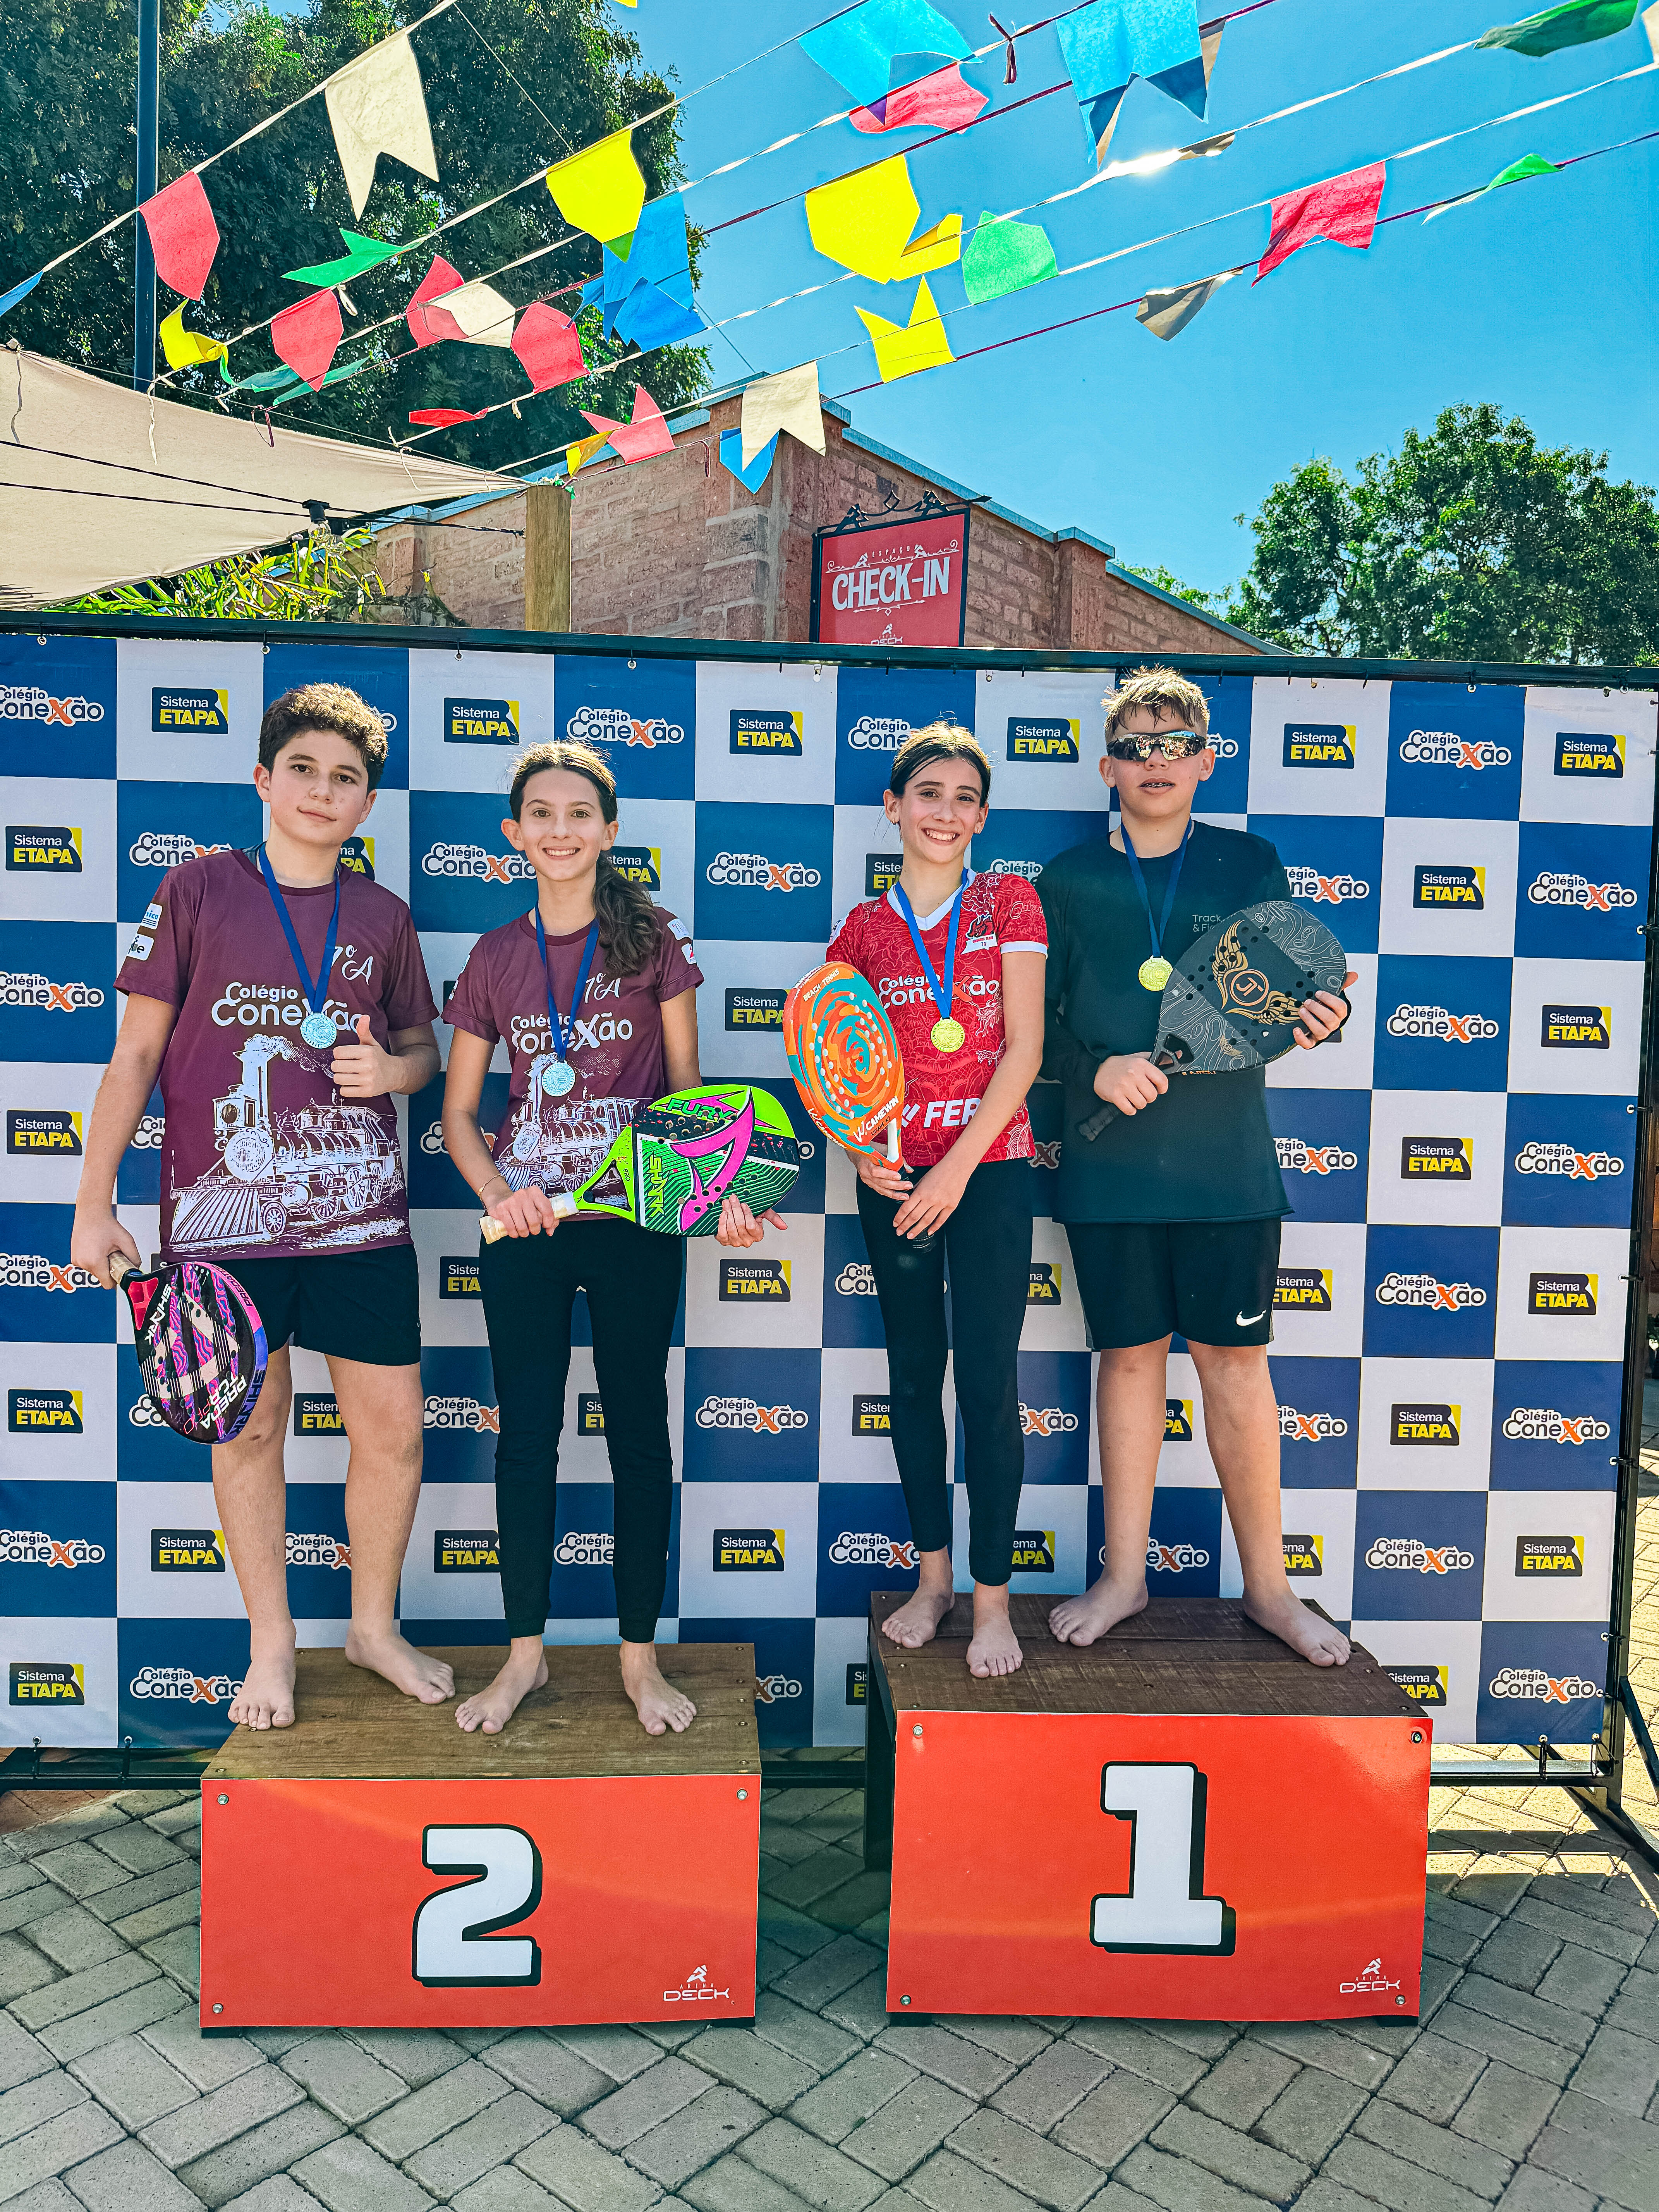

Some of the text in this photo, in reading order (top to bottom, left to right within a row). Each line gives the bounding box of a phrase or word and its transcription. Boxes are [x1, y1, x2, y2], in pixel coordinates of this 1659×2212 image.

[832, 556, 950, 611] CHECK-IN
[160, 697, 208, 708] Sistema
[160, 711, 220, 725] ETAPA
[452, 706, 500, 719] Sistema
[579, 708, 628, 723] Colégio
[452, 720, 510, 737] ETAPA
[738, 718, 783, 730] Sistema
[859, 718, 907, 733] Colégio
[1015, 725, 1060, 737] Sistema
[738, 732, 794, 748] ETAPA
[1292, 731, 1337, 744] Sistema
[1412, 732, 1458, 746] Colégio
[1015, 738, 1070, 755] ETAPA
[1290, 745, 1346, 761] ETAPA
[1563, 740, 1607, 752] Sistema
[1561, 753, 1616, 770] ETAPA
[14, 835, 62, 847] Sistema
[141, 834, 192, 849] Colégio
[14, 848, 72, 864] ETAPA
[434, 844, 483, 859] Colégio
[718, 853, 766, 868] Colégio
[874, 862, 903, 873] Siste
[993, 859, 1041, 874] Colégio
[1422, 874, 1466, 885] Sistema
[1537, 874, 1585, 888] Colégio
[1421, 886, 1476, 902] ETAPA
[1192, 914, 1221, 922] Track
[1193, 924, 1199, 932] &
[342, 956, 373, 986] A
[225, 982, 298, 1001] Colégio
[803, 968, 840, 1002] BEACH TENNIS
[733, 996, 778, 1007] Sistema
[1398, 1005, 1446, 1020] Colégio
[1549, 1013, 1593, 1025] Sistema
[1549, 1026, 1602, 1041] ETAPA
[667, 1097, 736, 1121] FURY
[15, 1119, 63, 1131] Sistema
[15, 1132, 74, 1147] ETAPA
[1410, 1144, 1454, 1156] Sistema
[1525, 1143, 1572, 1158] Colégio
[1409, 1158, 1463, 1173] ETAPA
[623, 1168, 631, 1181] PRO
[648, 1155, 665, 1218] SHARK
[449, 1265, 479, 1275] Siste
[728, 1267, 772, 1278] Sistema
[448, 1277, 481, 1291] ETA
[727, 1280, 783, 1294] ETAPA
[1277, 1276, 1314, 1287] istema
[1386, 1276, 1434, 1290] Colégio
[1537, 1281, 1580, 1292] Sistema
[1536, 1293, 1589, 1308] ETAPA
[17, 1397, 63, 1409] Sistema
[199, 1375, 247, 1429] PREDA
[426, 1398, 476, 1411] Colégio
[707, 1397, 754, 1412] Colégio
[861, 1402, 890, 1413] Siste
[17, 1411, 74, 1425] ETAPA
[860, 1415, 890, 1429] ETA
[1399, 1411, 1443, 1422] Sistema
[1514, 1409, 1559, 1422] Colégio
[1398, 1425, 1452, 1438] ETAPA
[160, 1537, 206, 1548] Sistema
[443, 1538, 489, 1547] Sistema
[721, 1537, 766, 1548] Sistema
[840, 1533, 887, 1547] Colégio
[1377, 1540, 1422, 1553] Colégio
[1523, 1543, 1566, 1554] Sistema
[159, 1550, 217, 1564] ETAPA
[442, 1551, 499, 1565] ETAPA
[721, 1550, 776, 1564] ETAPA
[1522, 1556, 1575, 1570] ETAPA
[18, 1671, 64, 1681] Sistema
[141, 1668, 191, 1681] Colégio
[1501, 1669, 1546, 1682] Colégio
[18, 1683, 76, 1698] ETAPA
[1090, 1761, 1236, 1956] 1
[412, 1824, 542, 1987] 2
[1340, 1980, 1401, 1993] DECK
[663, 1988, 730, 2001] DECK
